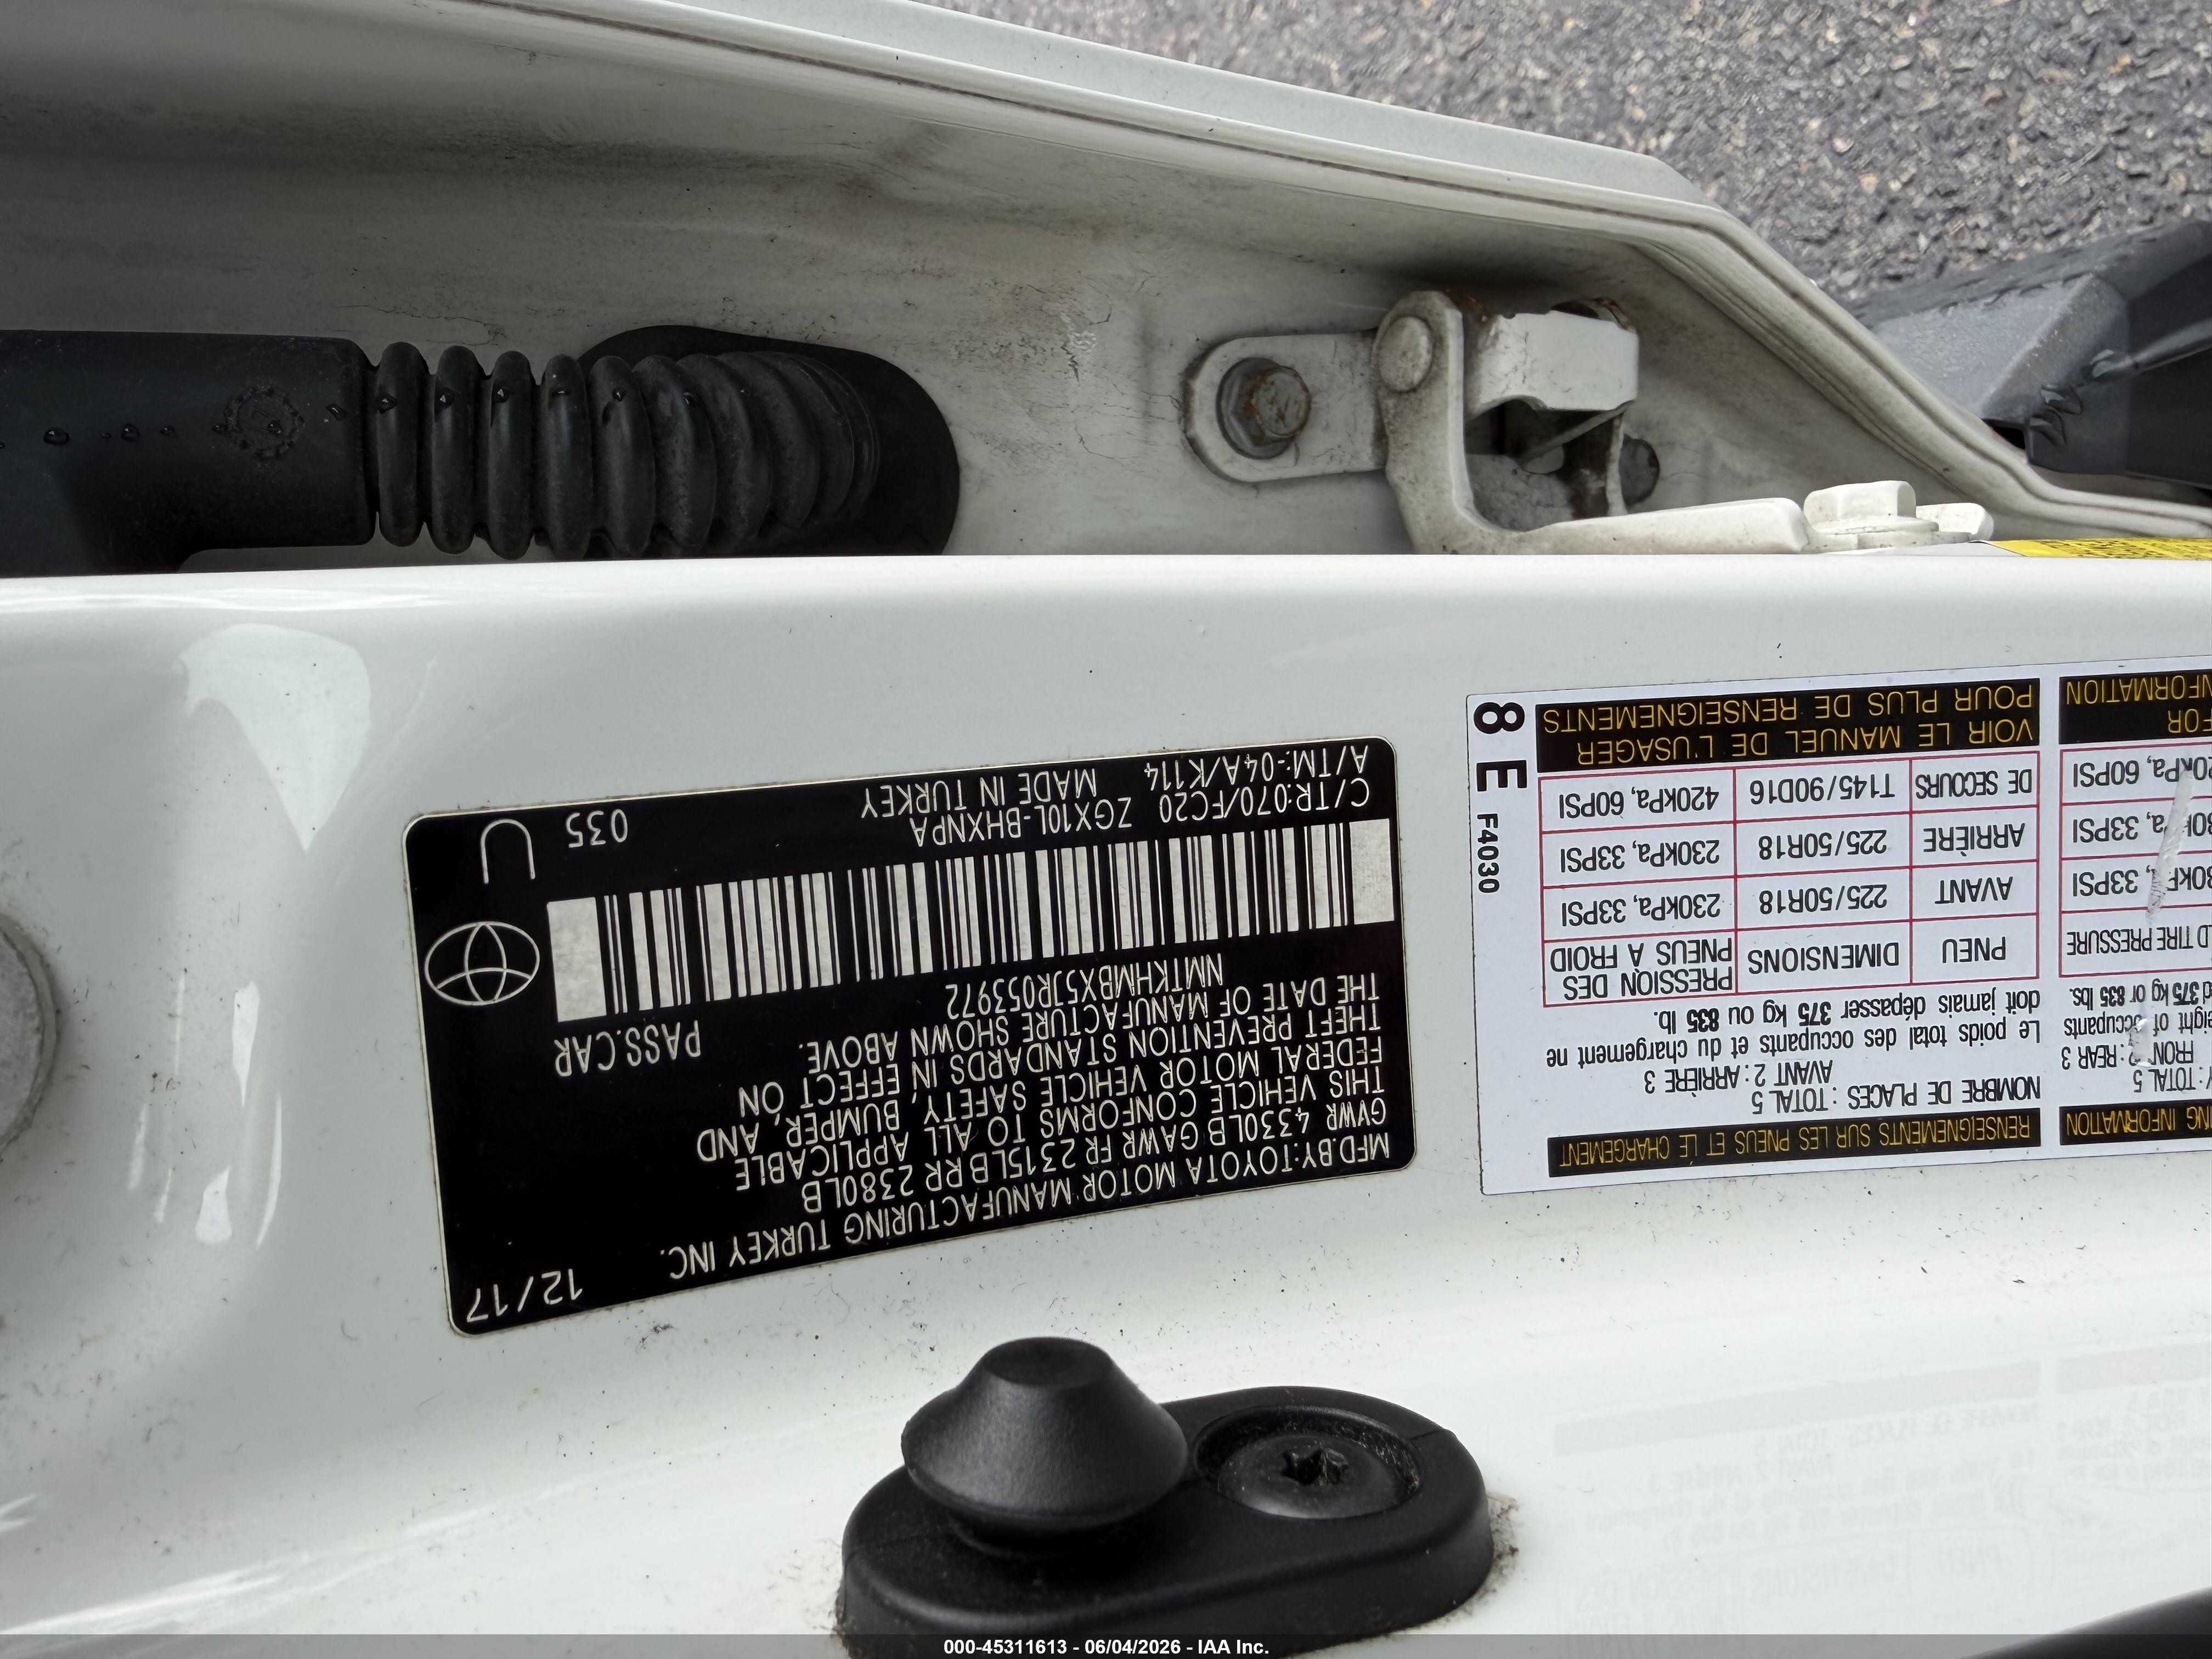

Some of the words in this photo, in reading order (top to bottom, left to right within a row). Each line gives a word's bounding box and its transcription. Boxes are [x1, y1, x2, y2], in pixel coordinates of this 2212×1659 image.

[1814, 693, 1850, 718] DE
[1867, 690, 1938, 715] PLUS
[1955, 684, 2032, 711] POUR
[1473, 702, 1526, 735] 8
[1543, 696, 1797, 733] RENSEIGNEMENTS
[1731, 732, 1768, 757] DE
[1785, 725, 1900, 753] MANUEL
[1918, 722, 1950, 747] LE
[1968, 718, 2033, 744] VOIR
[1577, 735, 1713, 765] L'USAGER
[1018, 768, 1096, 803] MADE
[1476, 760, 1527, 793] E
[1915, 771, 1999, 799] SECOURS
[2008, 769, 2032, 794] DE
[2073, 760, 2139, 787] 60PSI
[861, 779, 962, 817] TURKEY
[980, 776, 1005, 806] IN
[1631, 785, 1719, 812] 420kPa,
[1749, 773, 1895, 804] T145/90D16
[1559, 791, 1624, 819] 60PSI
[566, 808, 627, 848] 035
[1923, 822, 2025, 856] ARRIÈRE
[2073, 816, 2139, 843] 33PSI
[480, 819, 535, 883] U
[1476, 812, 1499, 894] F4030
[1560, 844, 1626, 873] 33PSI
[1632, 838, 1720, 867] 230kPa,
[1758, 829, 1888, 860] 225/50R18
[1935, 876, 2013, 904] AVANT
[2073, 870, 2138, 896] 33PSI
[1562, 898, 1626, 927] 33PSI
[1633, 892, 1721, 922] 230kPa,
[1759, 884, 1887, 915] 225/50R18
[1656, 937, 1732, 964] PNEUS
[1941, 936, 2006, 964] PNEU
[2067, 928, 2152, 955] PRESSURE
[2157, 926, 2193, 950] TIRE
[1550, 946, 1617, 973] FROID
[1627, 943, 1644, 975] À
[1748, 941, 1899, 974] DIMENSIONS
[1262, 978, 1327, 1011] DATE
[1336, 972, 1379, 1003] THE
[1562, 974, 1607, 1000] DES
[1621, 966, 1733, 997] PRESSION
[2100, 985, 2125, 1007] 835
[2130, 984, 2146, 1002] or
[2152, 978, 2168, 1006] kg
[2172, 981, 2199, 1006] 375
[1220, 986, 1251, 1015] OF
[1763, 1000, 1787, 1028] kg
[1798, 1002, 1832, 1026] 375
[1841, 992, 1926, 1022] dépasser
[1938, 987, 1996, 1018] jamais
[2005, 990, 2040, 1014] doit
[2069, 988, 2093, 1011] lbs.
[1023, 992, 1208, 1041] MANUFACTURE
[1305, 1002, 1381, 1041] THEFT
[1653, 1010, 1677, 1035] lb.
[1687, 1009, 1719, 1032] 835
[1729, 1006, 1753, 1025] ou
[2152, 1013, 2169, 1037] of
[910, 1020, 1009, 1056] SHOWN
[1128, 1012, 1291, 1057] PREVENTION
[1759, 1029, 1854, 1058] occupants
[1864, 1028, 1897, 1051] des
[1910, 1025, 1947, 1050] total
[1959, 1017, 2006, 1046] poids
[2019, 1020, 2040, 1043] Le
[554, 1020, 701, 1076] PASS.CAR
[798, 1031, 898, 1073] ABOVE.
[950, 1035, 1116, 1084] STANDARDS
[1271, 1035, 1383, 1075] FEDERAL
[1546, 1048, 1567, 1068] ne
[1578, 1037, 1688, 1069] chargement
[1698, 1037, 1722, 1063] du
[1730, 1036, 1748, 1059] et
[2061, 1047, 2070, 1070] 3
[2078, 1045, 2117, 1069] REAR
[911, 1061, 937, 1090] IN
[1160, 1049, 1260, 1088] MOTOR
[1329, 1065, 1385, 1099] THIS
[1644, 1070, 1655, 1093] 3
[1664, 1065, 1740, 1098] ARRIÈRE
[1754, 1063, 1765, 1086] 2
[1774, 1060, 1832, 1086] AVANT
[2132, 1069, 2143, 1093] 5
[2148, 1066, 2196, 1092] TOTAL
[738, 1082, 783, 1117] ON
[802, 1063, 898, 1108] EFFECT
[1041, 1064, 1147, 1107] VEHICLE
[1210, 1073, 1317, 1115] VEHICLE
[1848, 1083, 1917, 1109] PLACES
[1928, 1081, 1951, 1105] DE
[1962, 1076, 2041, 1103] NOMBRE
[911, 1084, 1026, 1124] SAFETY,
[1040, 1087, 1197, 1138] CONFORMS
[1326, 1096, 1386, 1131] GVWR
[1752, 1091, 1763, 1115] 5
[1769, 1088, 1828, 1113] TOTAL
[775, 1099, 900, 1147] BUMPER,
[988, 1117, 1027, 1145] TO
[1208, 1107, 1310, 1146] 4330LB
[1836, 1124, 1871, 1148] SUR
[1878, 1114, 2030, 1144] RENSEIGNEMENTS
[2067, 1108, 2176, 1136] INFORMATION
[696, 1122, 760, 1162] AND
[924, 1124, 972, 1157] ALL
[1086, 1135, 1111, 1163] FR
[1122, 1120, 1198, 1159] GAWR
[1559, 1136, 1669, 1167] CHARGEMENT
[1679, 1133, 1697, 1159] LE
[1707, 1132, 1725, 1156] ET
[1735, 1128, 1790, 1154] PNEUS
[1799, 1126, 1828, 1150] LES
[734, 1131, 909, 1190] APPLICABLE
[969, 1137, 1076, 1184] 2315LB
[1184, 1131, 1389, 1186] MFD.BY:TOYOTA
[802, 1165, 914, 1214] 2380LB
[924, 1160, 962, 1191] RR
[1082, 1160, 1175, 1202] MOTOR
[843, 1181, 1071, 1244] MANUFACTURING
[727, 1219, 830, 1266] TURKEY
[660, 1241, 716, 1278] INC.
[466, 1268, 582, 1323] 12/17
